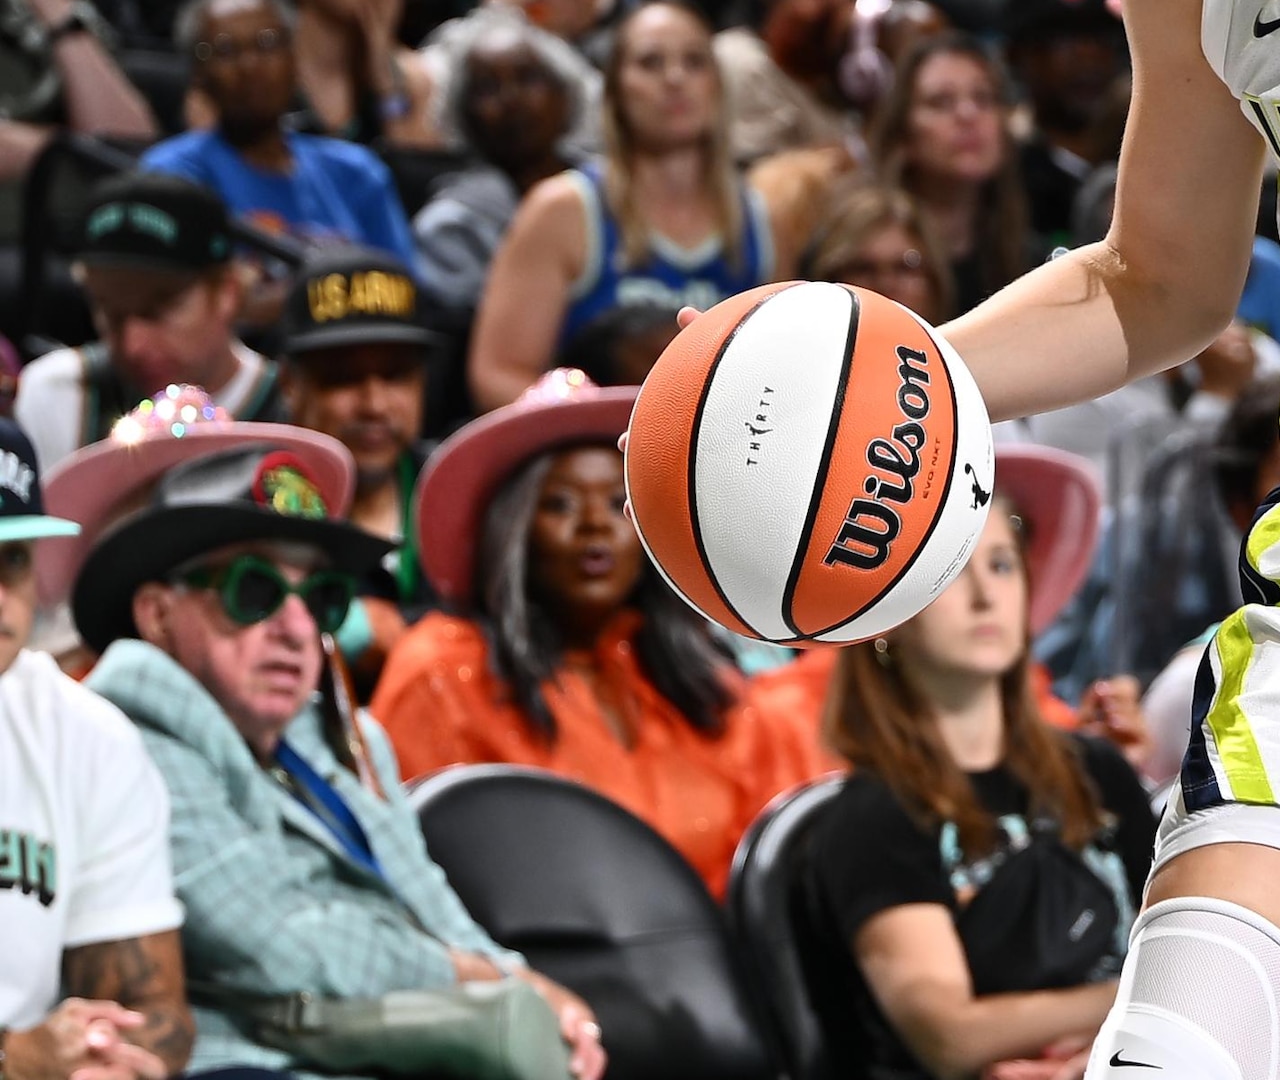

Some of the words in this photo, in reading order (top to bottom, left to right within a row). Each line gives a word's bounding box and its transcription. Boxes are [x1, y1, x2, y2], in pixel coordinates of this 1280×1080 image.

[821, 344, 932, 573] Wilson
[922, 471, 935, 500] EVO
[931, 436, 942, 467] NXT
